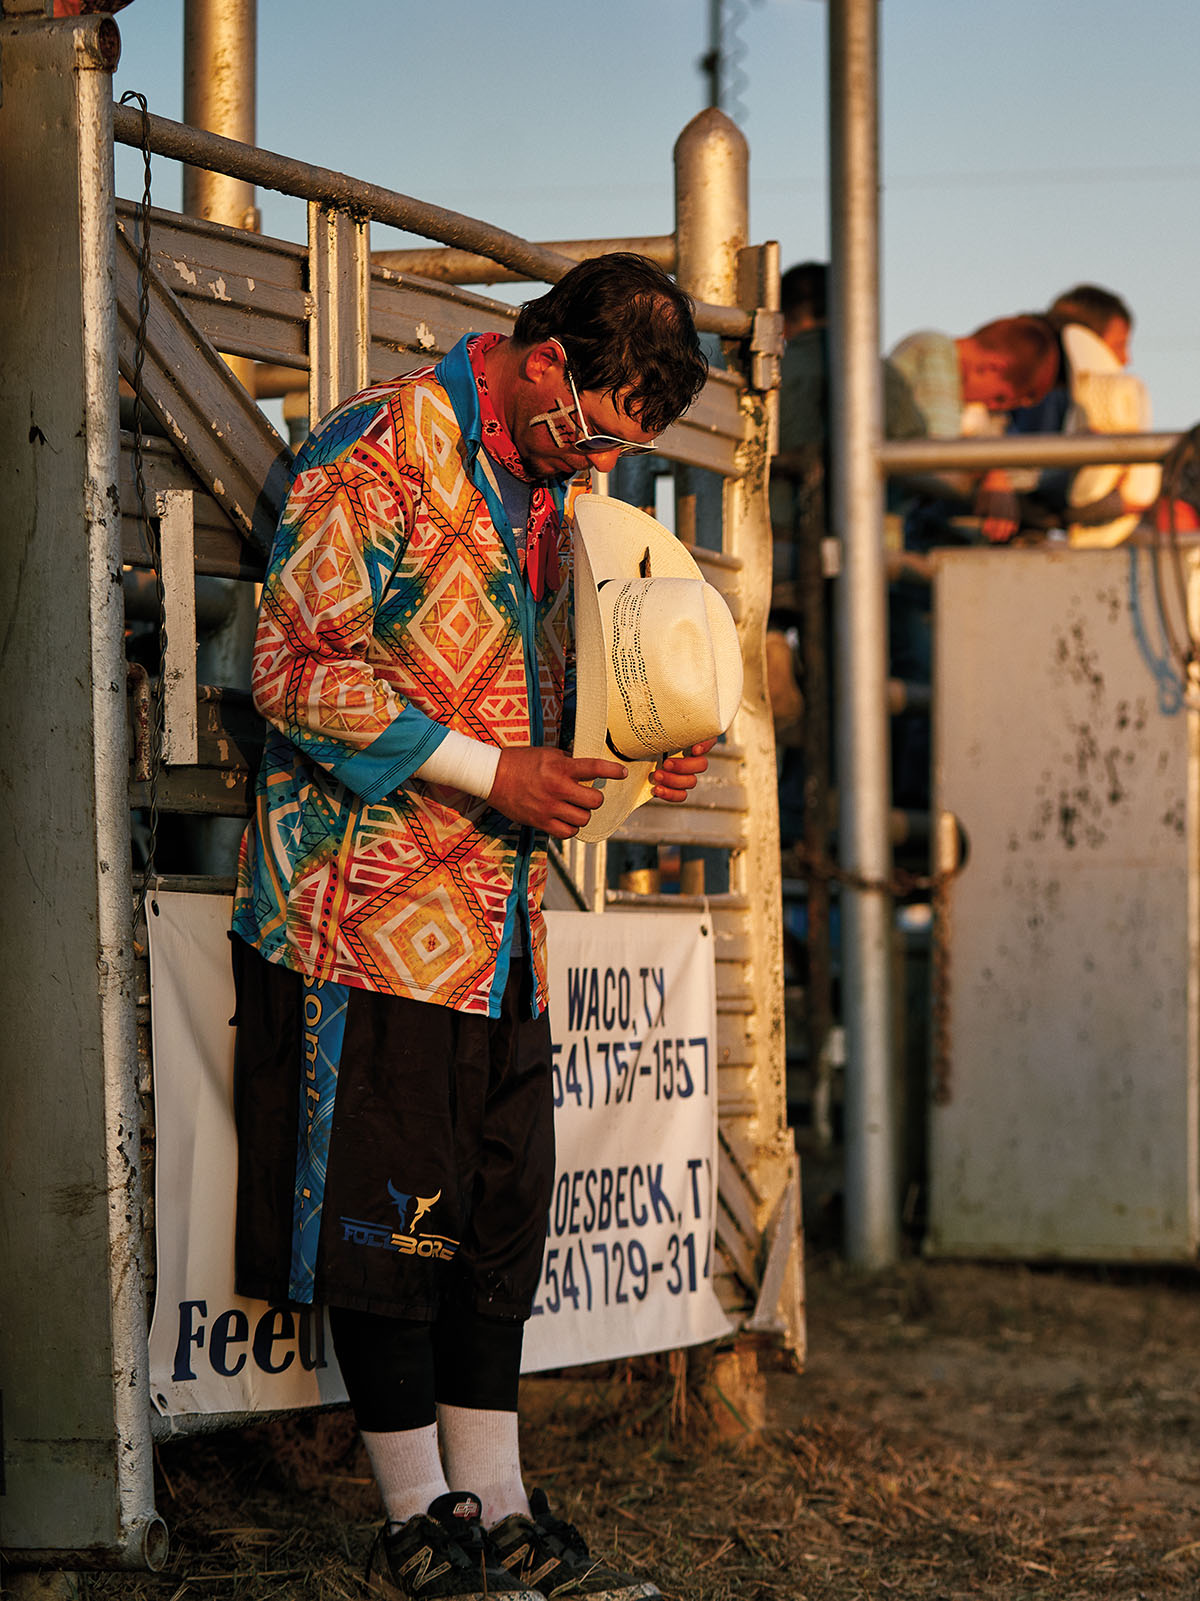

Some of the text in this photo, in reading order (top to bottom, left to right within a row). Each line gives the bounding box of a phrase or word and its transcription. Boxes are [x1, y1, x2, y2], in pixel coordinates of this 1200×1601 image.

[567, 967, 637, 1036] WACO,
[547, 1164, 682, 1238] OESBECK,
[171, 1300, 328, 1382] Feed
